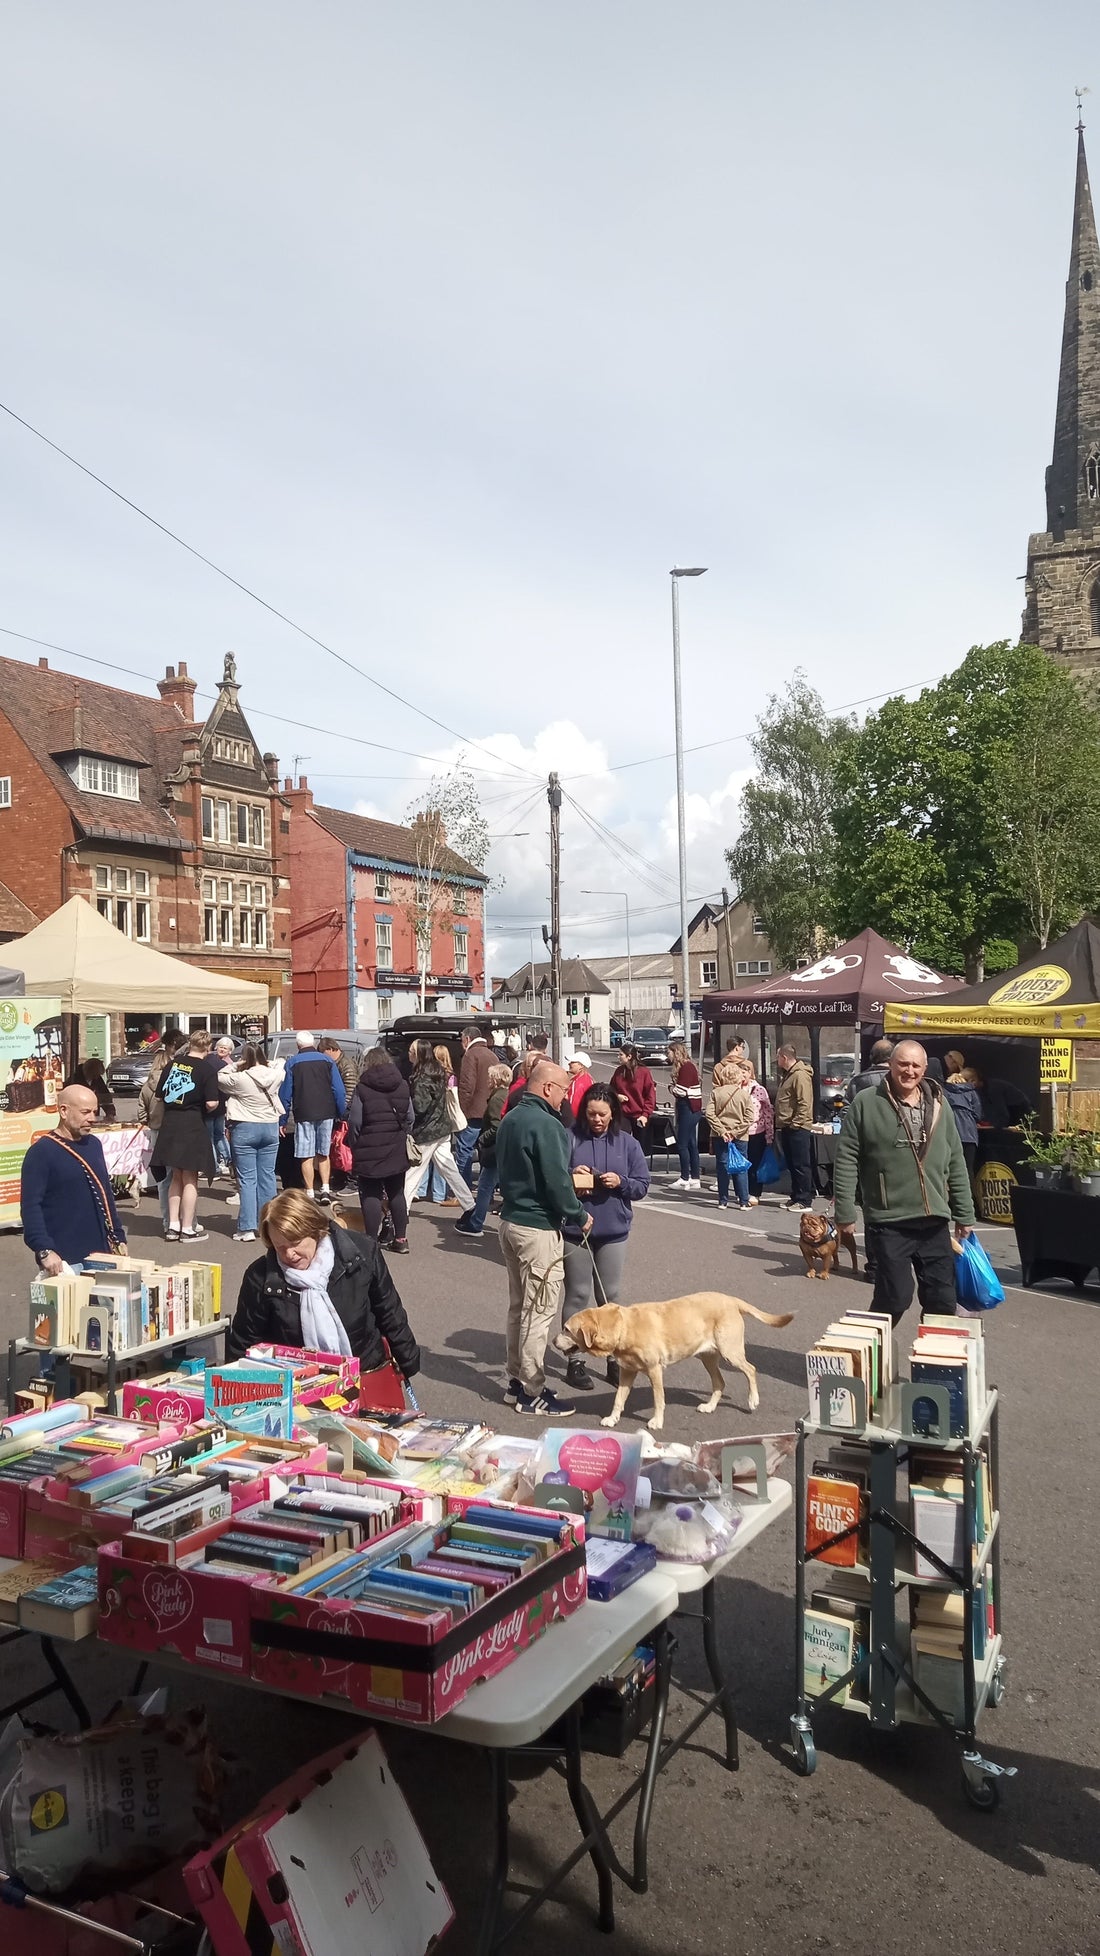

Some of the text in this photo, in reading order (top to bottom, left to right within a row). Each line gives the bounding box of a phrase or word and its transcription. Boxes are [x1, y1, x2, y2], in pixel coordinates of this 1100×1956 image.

[1005, 979, 1065, 992] MOUSE
[995, 991, 1051, 1003] HOUSE
[721, 1002, 743, 1013] Snail
[751, 1002, 779, 1014] Rabbit
[796, 1003, 818, 1013] Loose
[819, 1002, 837, 1013] Leaf
[837, 1001, 853, 1012] Tea
[1044, 1037, 1057, 1047] NO
[1042, 1048, 1071, 1058] RKING
[1041, 1059, 1062, 1069] THIS
[1040, 1070, 1070, 1080] UNDAY
[982, 1197, 1011, 1218] HOUS
[807, 1355, 846, 1370] BRYCE
[211, 1375, 283, 1408] THUNDERBIRDS
[162, 1403, 185, 1419] Pink
[809, 1499, 856, 1523] FLINT'S
[815, 1515, 849, 1535] CODE
[151, 1578, 183, 1602] Pink
[156, 1598, 187, 1617] Lady
[812, 1624, 834, 1640] Judy
[804, 1632, 847, 1653] Finnigan
[441, 1610, 526, 1695] Pink Lady
[144, 1747, 162, 1777] This
[120, 1767, 139, 1836] keeper
[145, 1779, 168, 1821] bag
